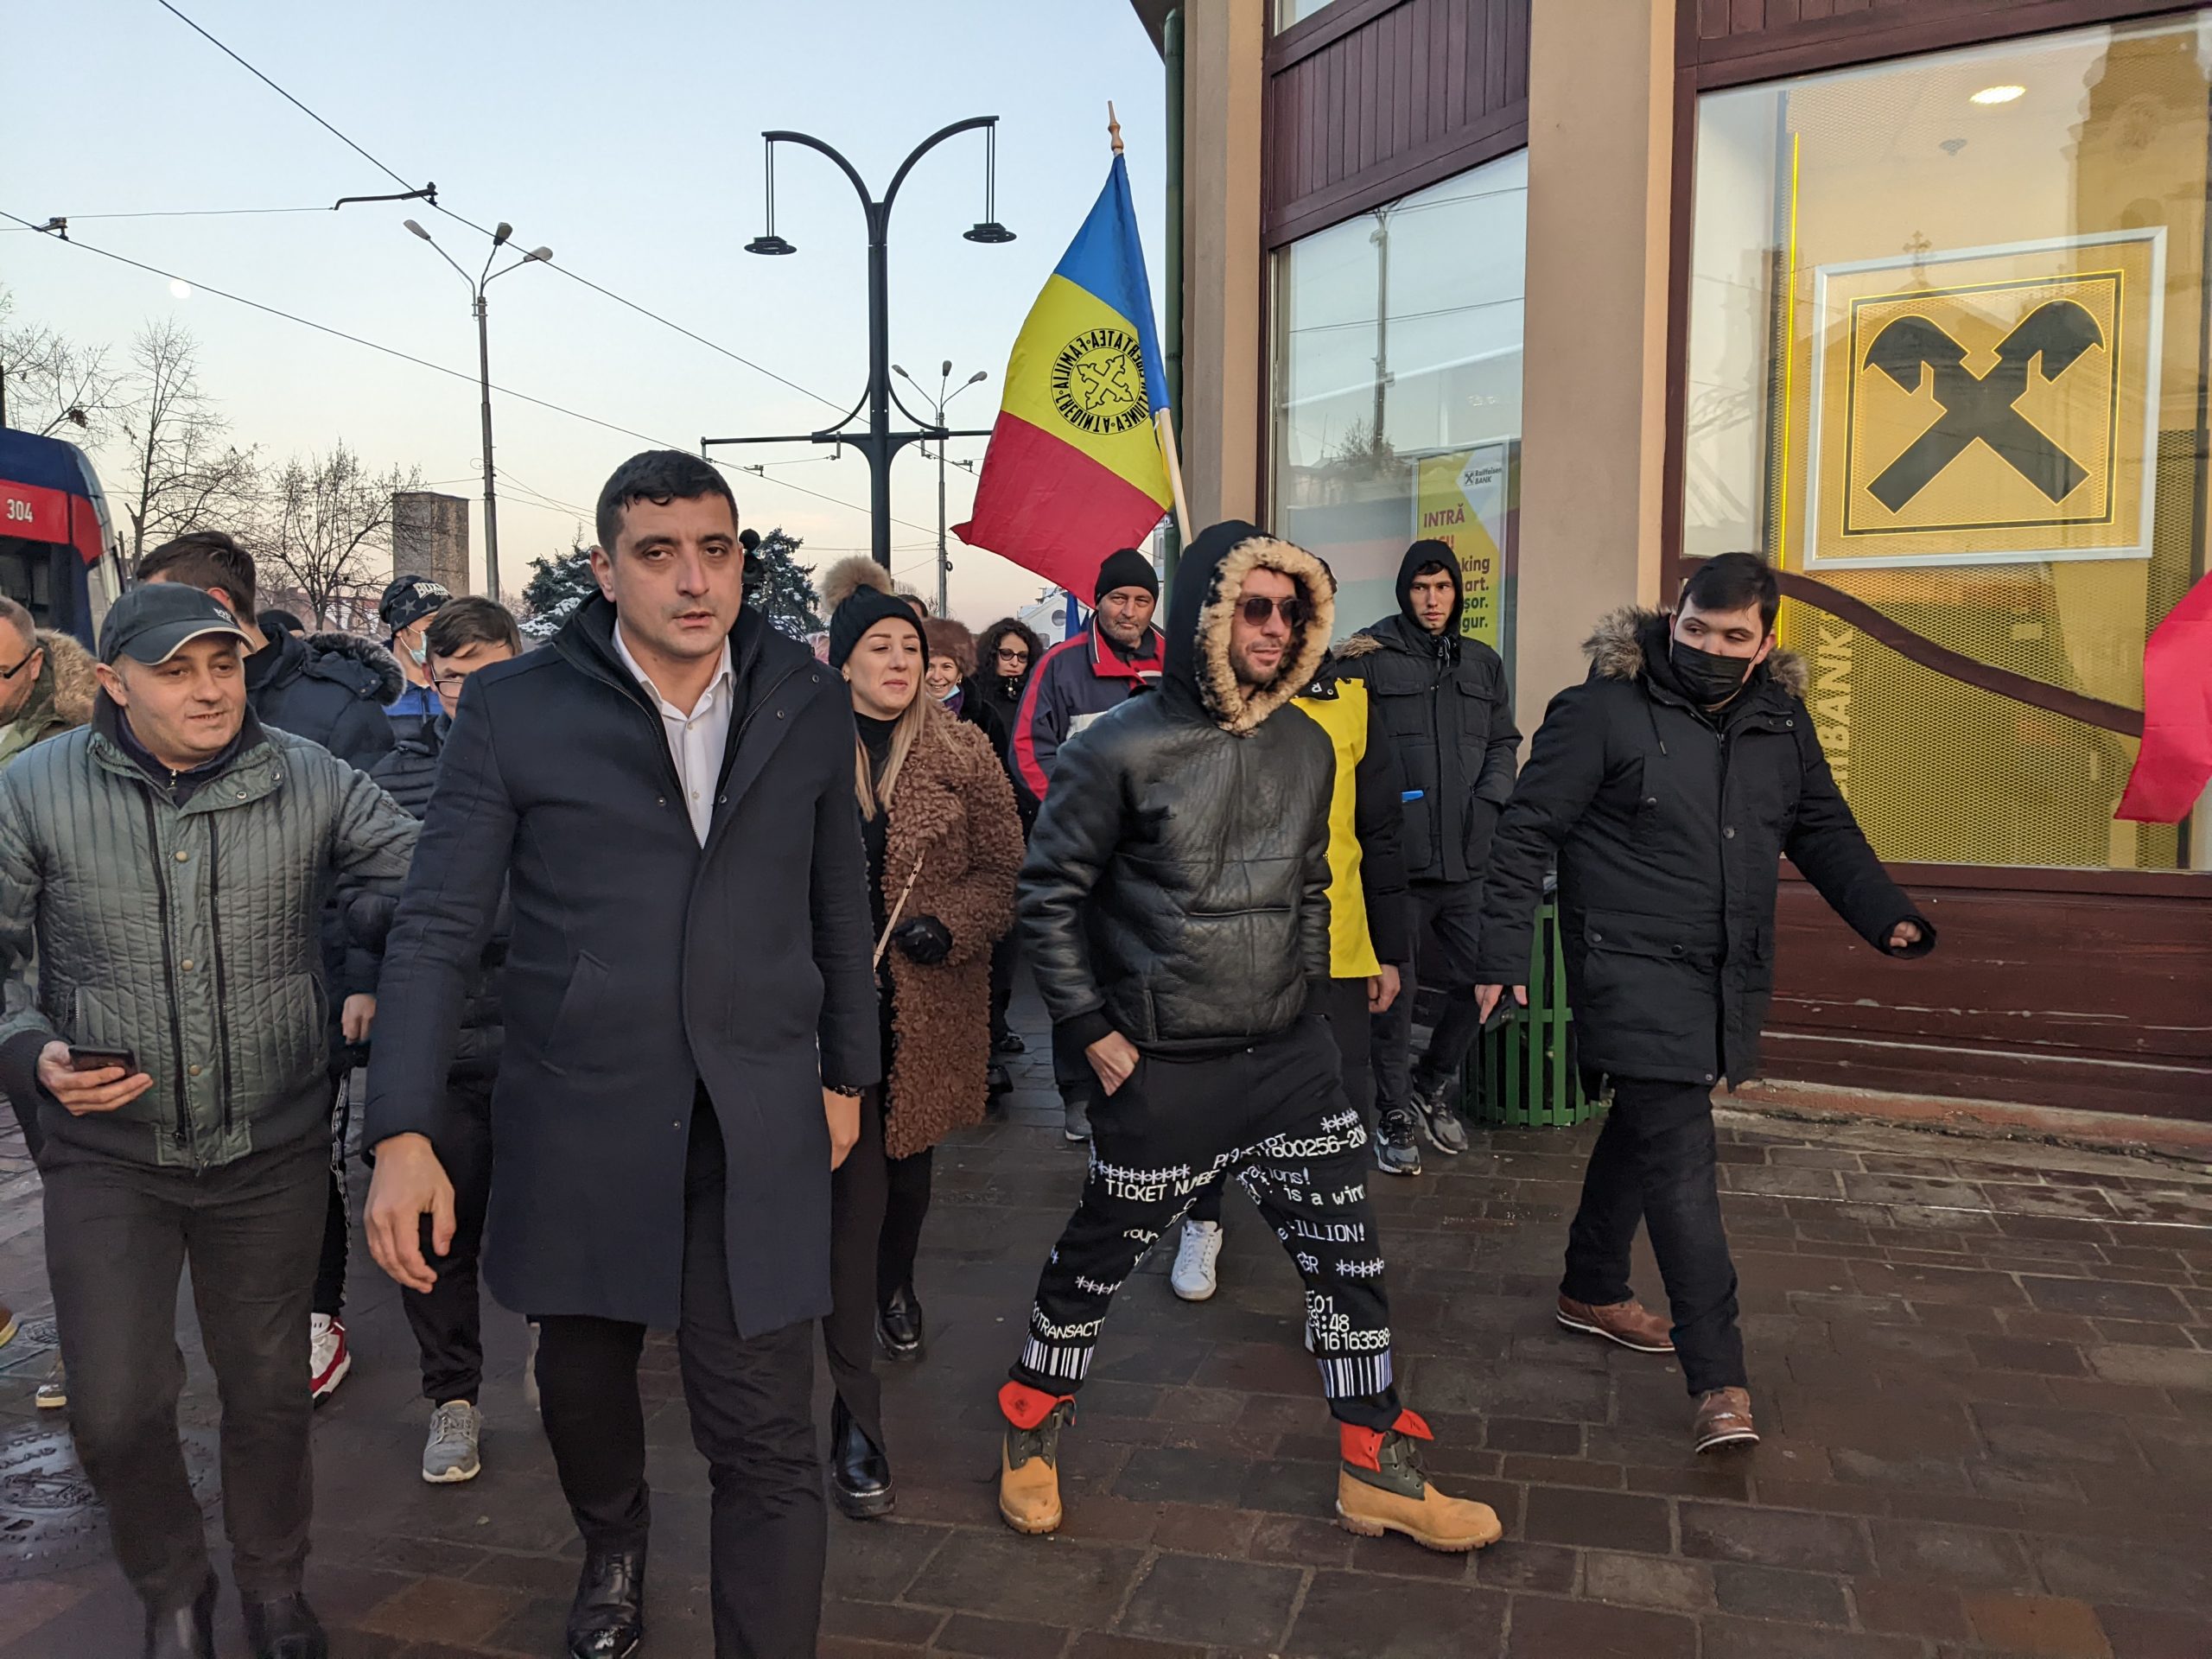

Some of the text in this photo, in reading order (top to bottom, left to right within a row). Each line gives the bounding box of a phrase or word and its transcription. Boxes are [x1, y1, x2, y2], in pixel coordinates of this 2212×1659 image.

[1474, 475, 1492, 484] BANK
[7, 498, 34, 523] 304
[1424, 503, 1465, 528] INTRĂ
[1461, 556, 1490, 574] king
[1463, 576, 1490, 592] art.
[1462, 616, 1488, 632] gur.
[1105, 1178, 1167, 1202] TICKET
[1283, 1185, 1302, 1202] is
[1311, 1192, 1324, 1205] a
